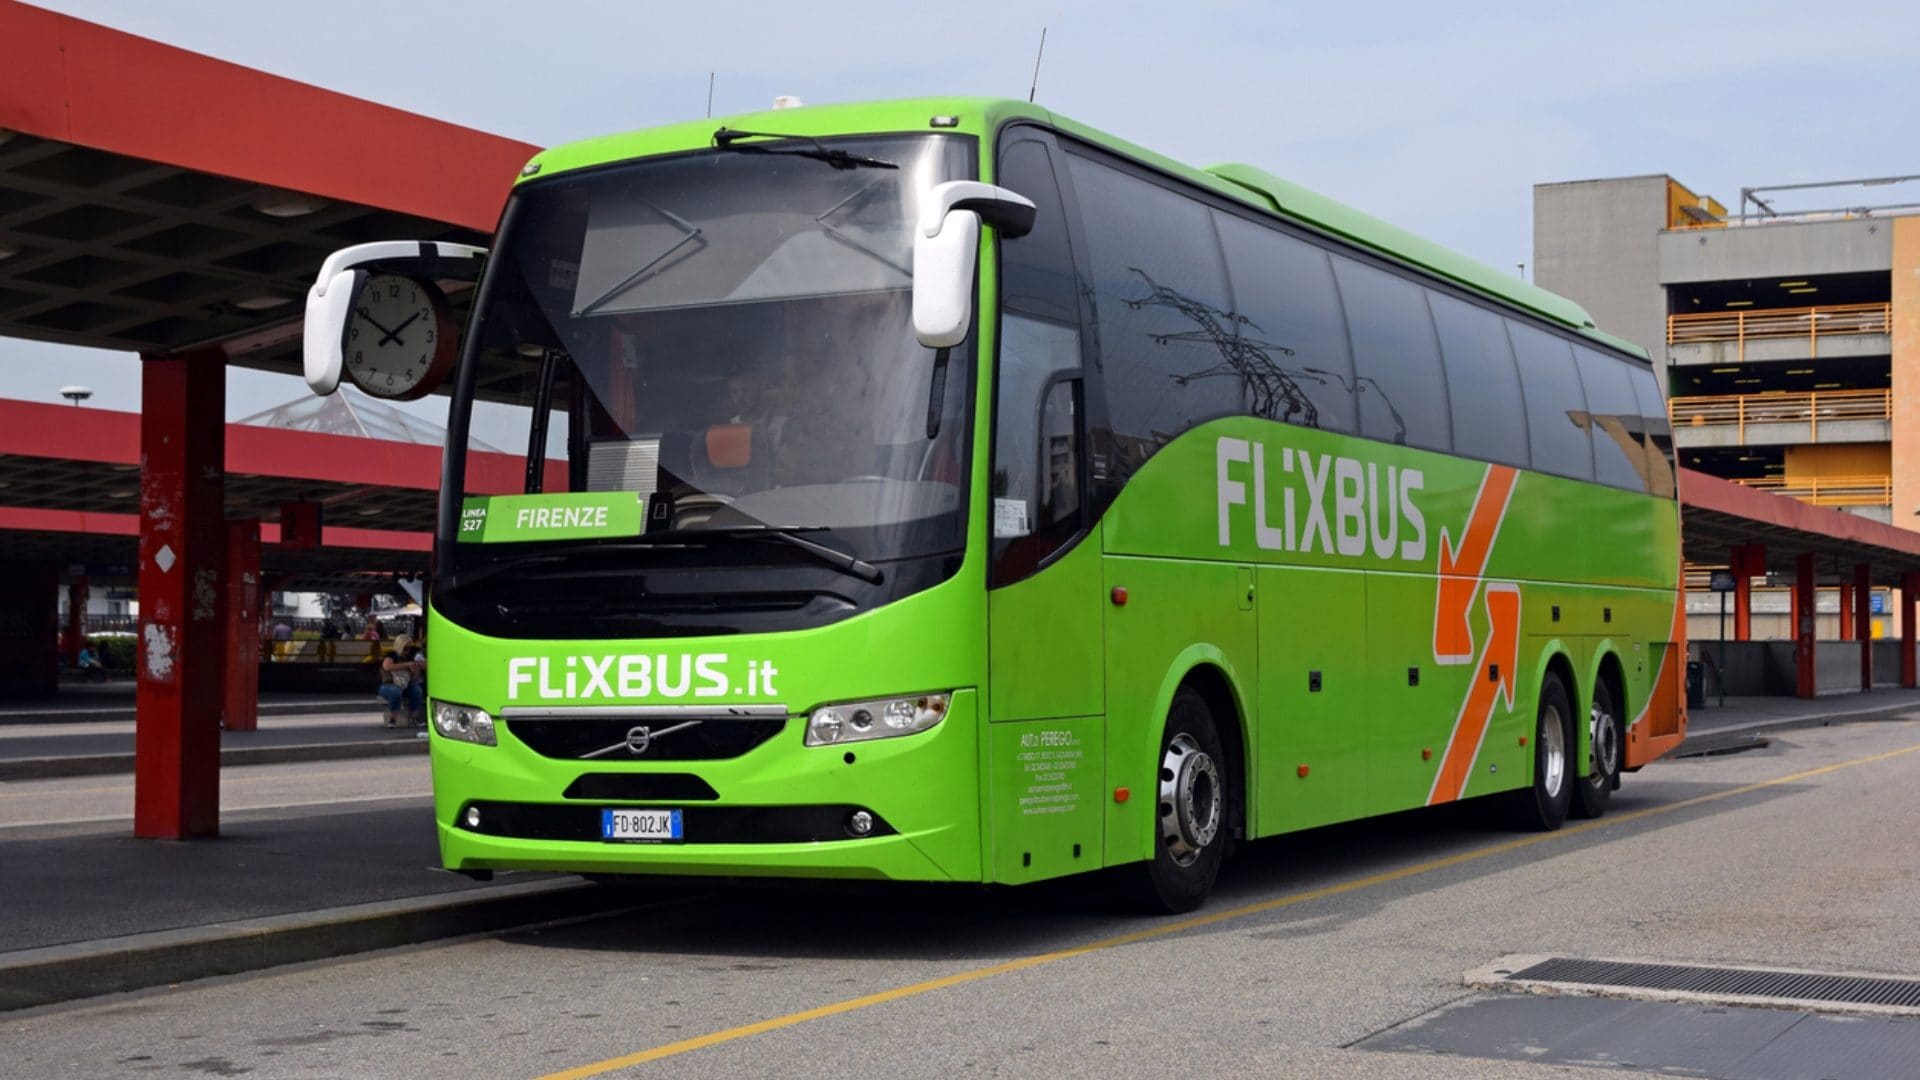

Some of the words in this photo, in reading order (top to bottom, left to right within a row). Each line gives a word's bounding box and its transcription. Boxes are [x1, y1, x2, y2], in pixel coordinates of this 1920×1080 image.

[372, 290, 381, 303] 11
[389, 284, 399, 298] 12
[411, 291, 416, 304] 1
[422, 307, 430, 321] 2
[351, 327, 359, 340] 9
[426, 329, 434, 343] 3
[355, 351, 363, 364] 8
[419, 353, 427, 365] 4
[369, 367, 377, 380] 7
[386, 372, 394, 386] 6
[406, 369, 413, 381] 5
[463, 508, 487, 518] LINEA
[516, 506, 609, 529] FIRENZE
[463, 519, 483, 531] 527
